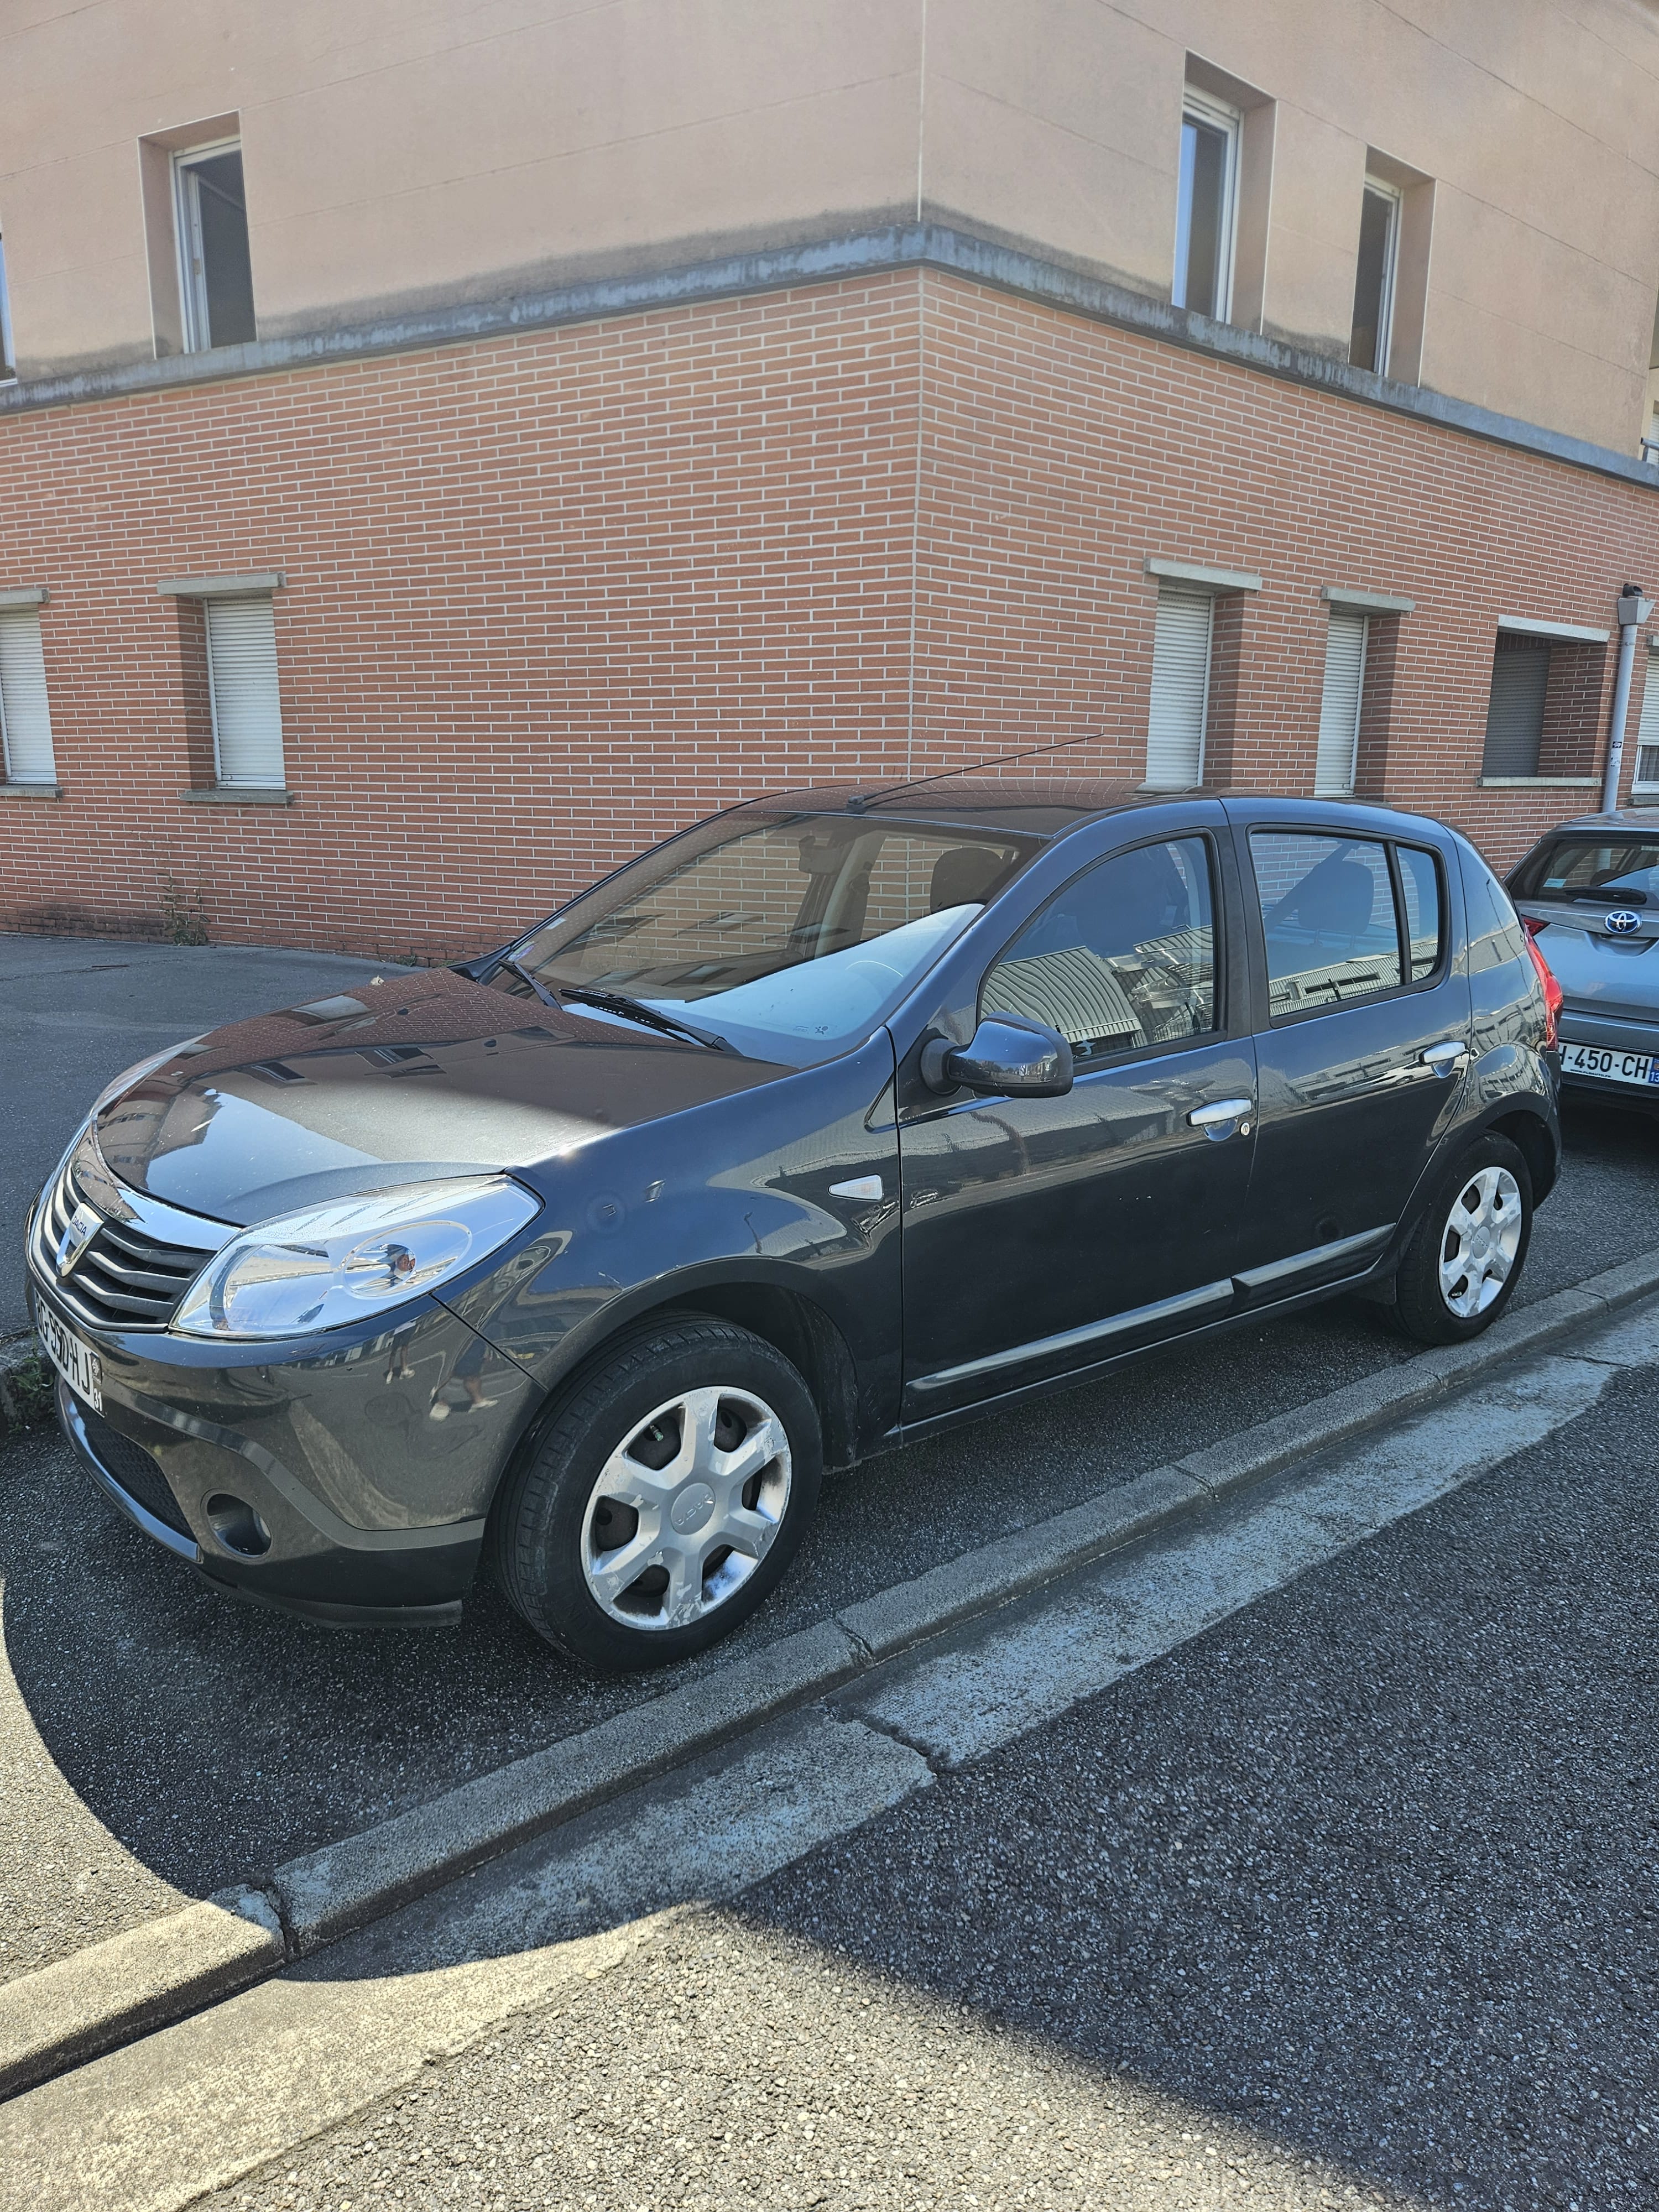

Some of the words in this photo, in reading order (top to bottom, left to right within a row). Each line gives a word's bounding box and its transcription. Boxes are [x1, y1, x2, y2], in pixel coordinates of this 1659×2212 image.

[1558, 1045, 1649, 1079] H-450-CH
[72, 1215, 87, 1236] DACIA
[93, 1388, 102, 1412] 31
